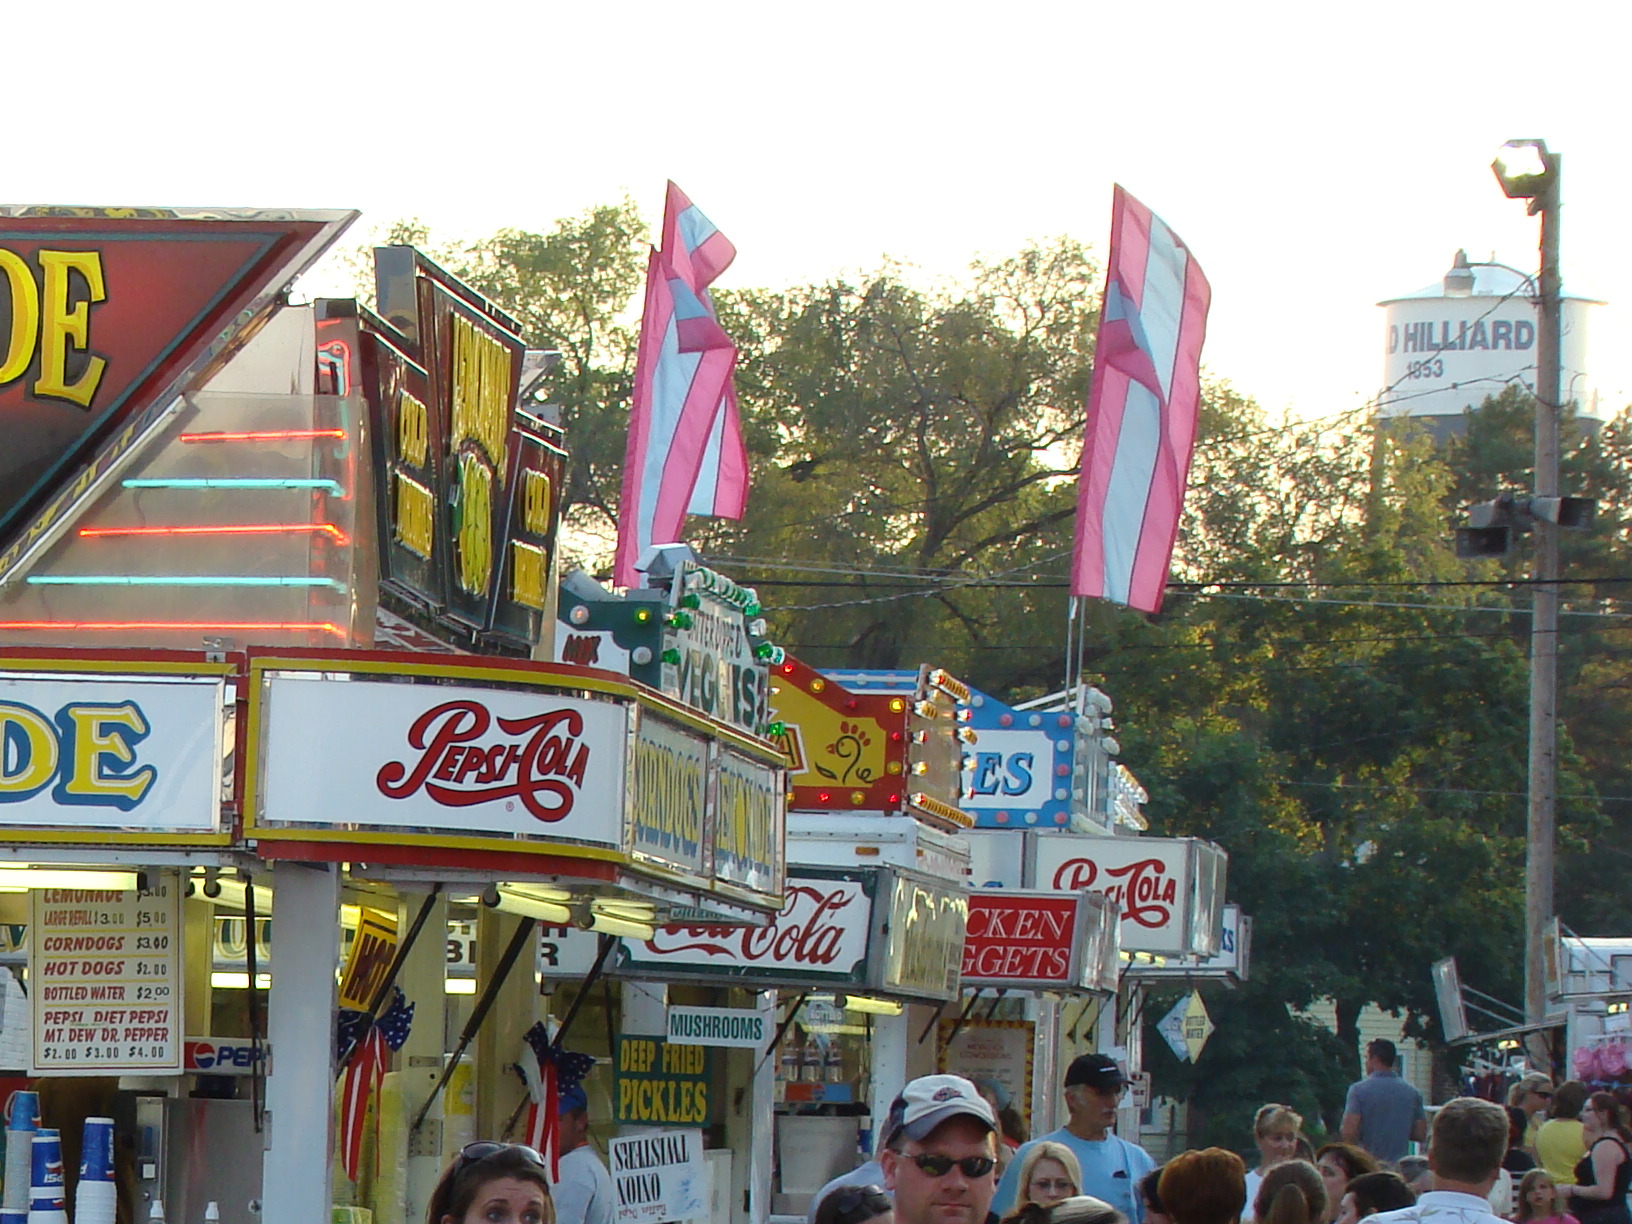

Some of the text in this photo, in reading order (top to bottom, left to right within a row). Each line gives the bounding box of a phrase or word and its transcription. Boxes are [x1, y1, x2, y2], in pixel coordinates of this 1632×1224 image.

[1404, 319, 1536, 354] HILLIARD
[1406, 358, 1444, 380] 1853
[43, 889, 123, 904] LEMONADE
[44, 910, 67, 926] LARGE
[68, 910, 92, 927] REFILL
[136, 911, 166, 928] $5.00
[44, 936, 125, 952] CORNDOGS
[136, 936, 168, 950] $3.00
[44, 961, 167, 976] HOT DOGS $2.00
[44, 985, 170, 1001] BOTTLED WATER $2.00
[43, 1011, 84, 1025] PEPSI
[93, 1010, 127, 1025] DIET
[128, 1010, 169, 1024] PEPSI
[43, 1027, 169, 1043] MT. DEW DR. PEPPER
[670, 1013, 763, 1041] MUSHROOMS
[44, 1046, 164, 1060] $2.00 $3.00 $4.00
[620, 1039, 705, 1075] DEEP FRIED
[618, 1078, 707, 1123] PICKLES
[614, 1134, 690, 1172] TWISTERS
[616, 1171, 661, 1207] ONION
